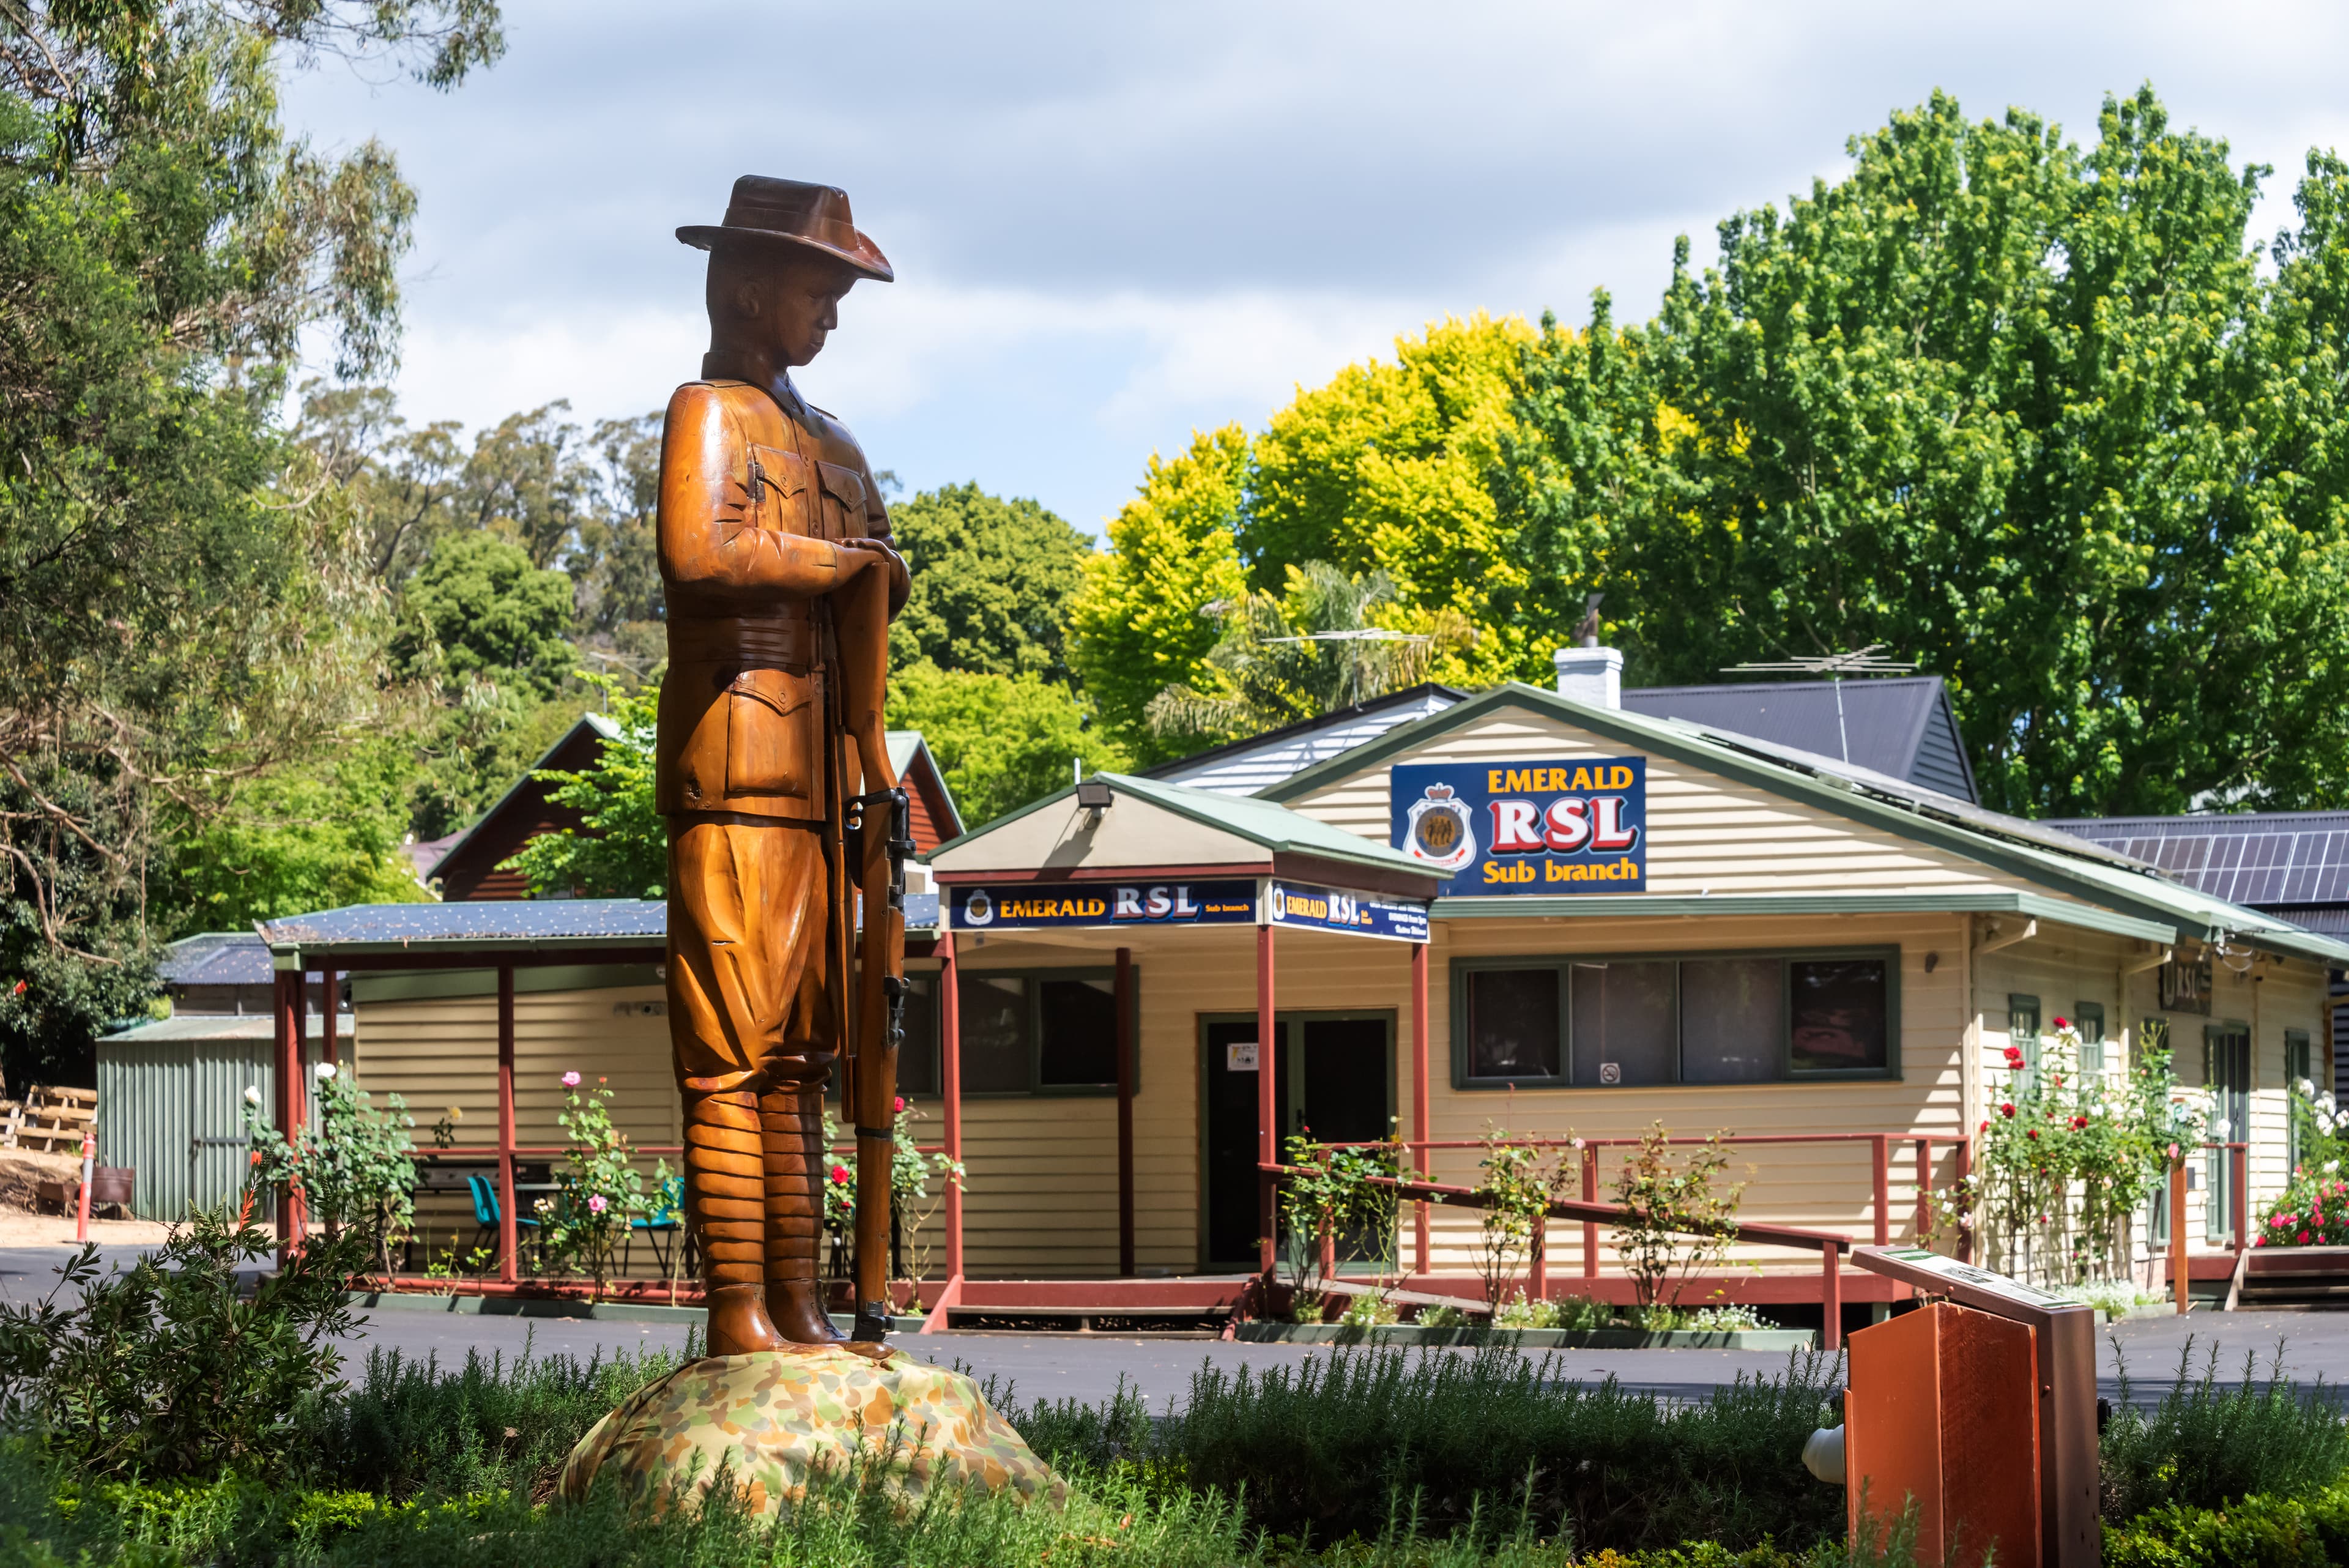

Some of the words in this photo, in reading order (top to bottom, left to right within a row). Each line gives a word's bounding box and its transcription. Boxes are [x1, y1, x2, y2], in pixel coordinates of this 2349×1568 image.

[1488, 766, 1634, 793] EMERALD
[1488, 796, 1638, 856] RSL
[1483, 860, 1536, 883] Sub
[1545, 857, 1639, 882] branch
[1000, 898, 1105, 918] EMERALD
[1111, 886, 1201, 923] RSL
[1222, 903, 1249, 912] branch
[1286, 896, 1327, 919] EMERALD
[1328, 893, 1360, 928] RSL
[2176, 966, 2197, 999] RSL
